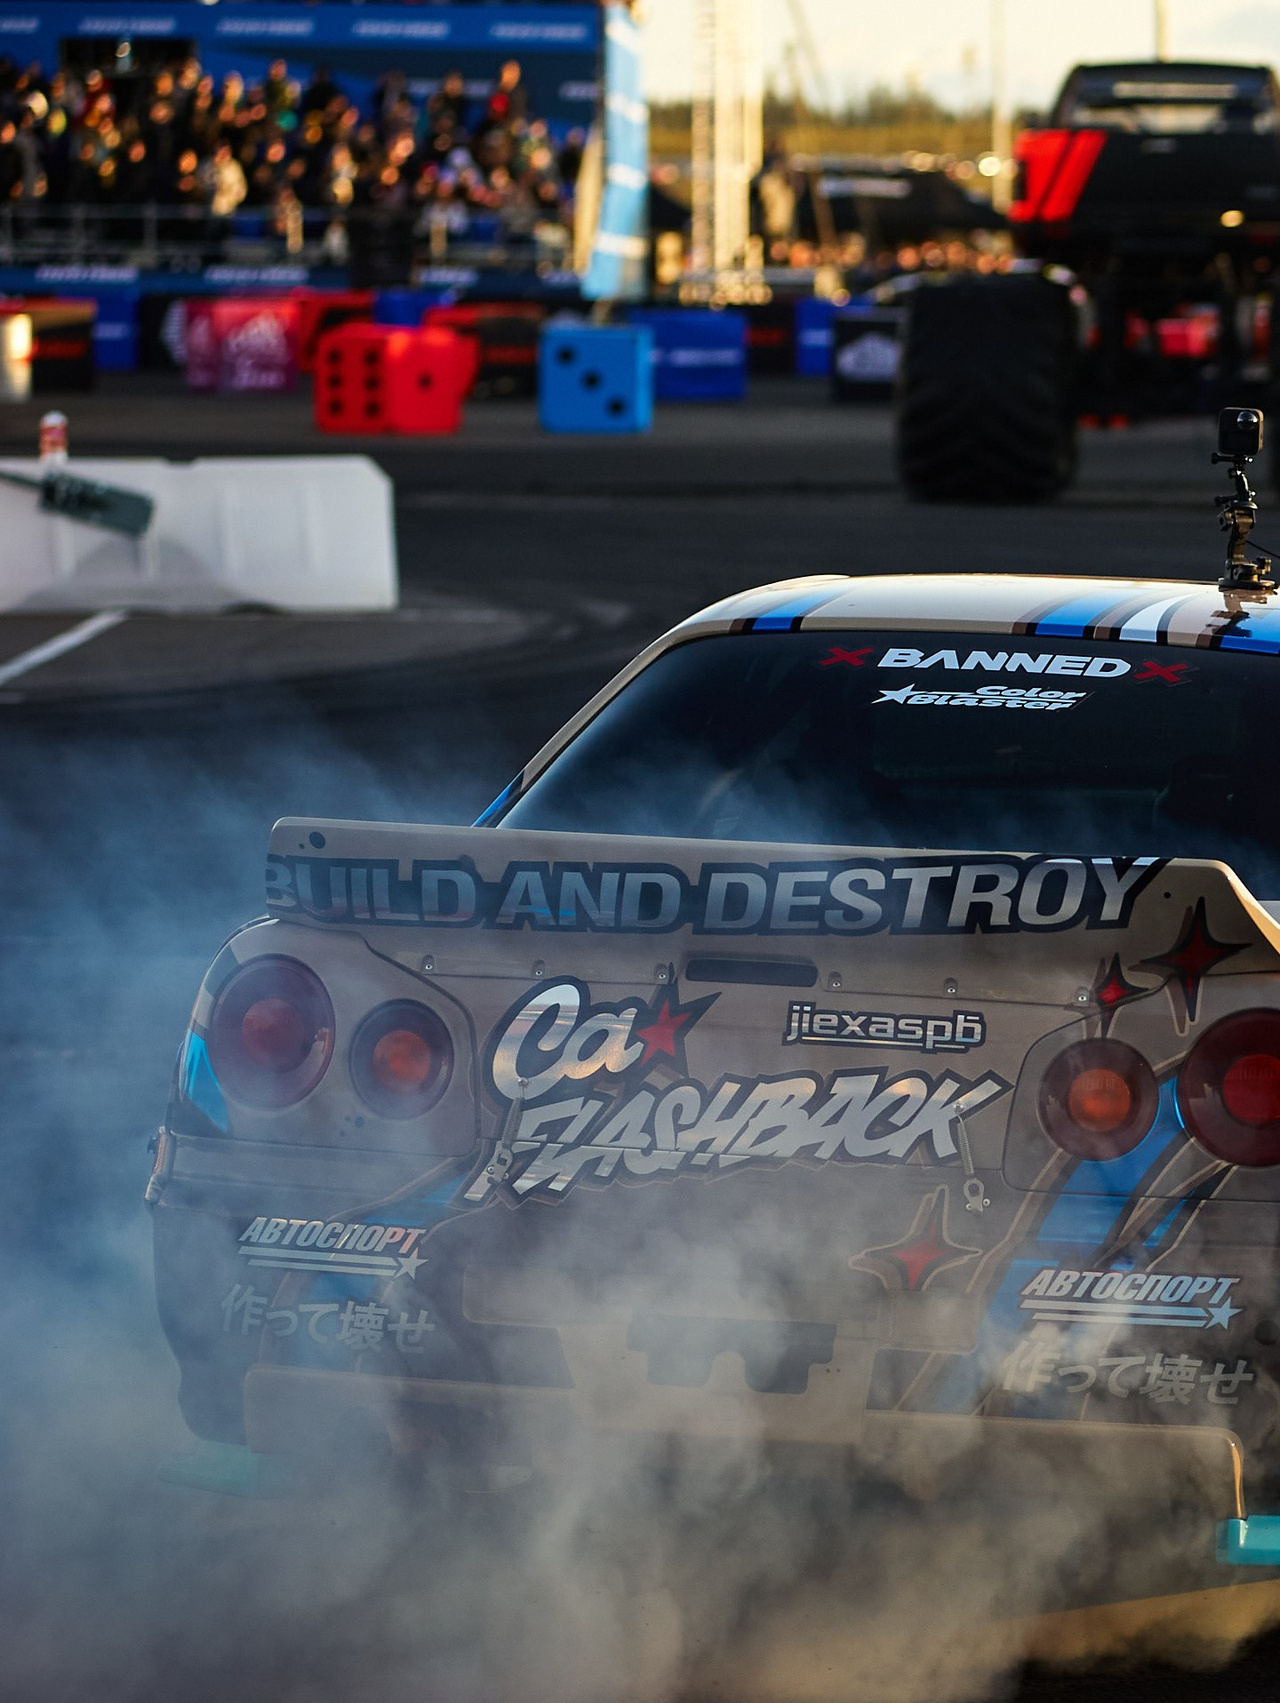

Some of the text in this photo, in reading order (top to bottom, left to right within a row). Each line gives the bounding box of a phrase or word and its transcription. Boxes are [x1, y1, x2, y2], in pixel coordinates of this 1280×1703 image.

[877, 648, 1132, 678] BANNED
[906, 693, 1077, 712] Blaster
[975, 685, 1087, 701] Color
[264, 856, 1160, 930] BUILD AND DESTROY
[463, 1073, 1002, 1201] FLASHBACK
[238, 1216, 427, 1254] АВТОСПОРТ
[1020, 1269, 1241, 1304] АВТОСПОРТ
[221, 1283, 436, 1353] 作って壊せ
[1002, 1339, 1255, 1405] 作って壊せ
